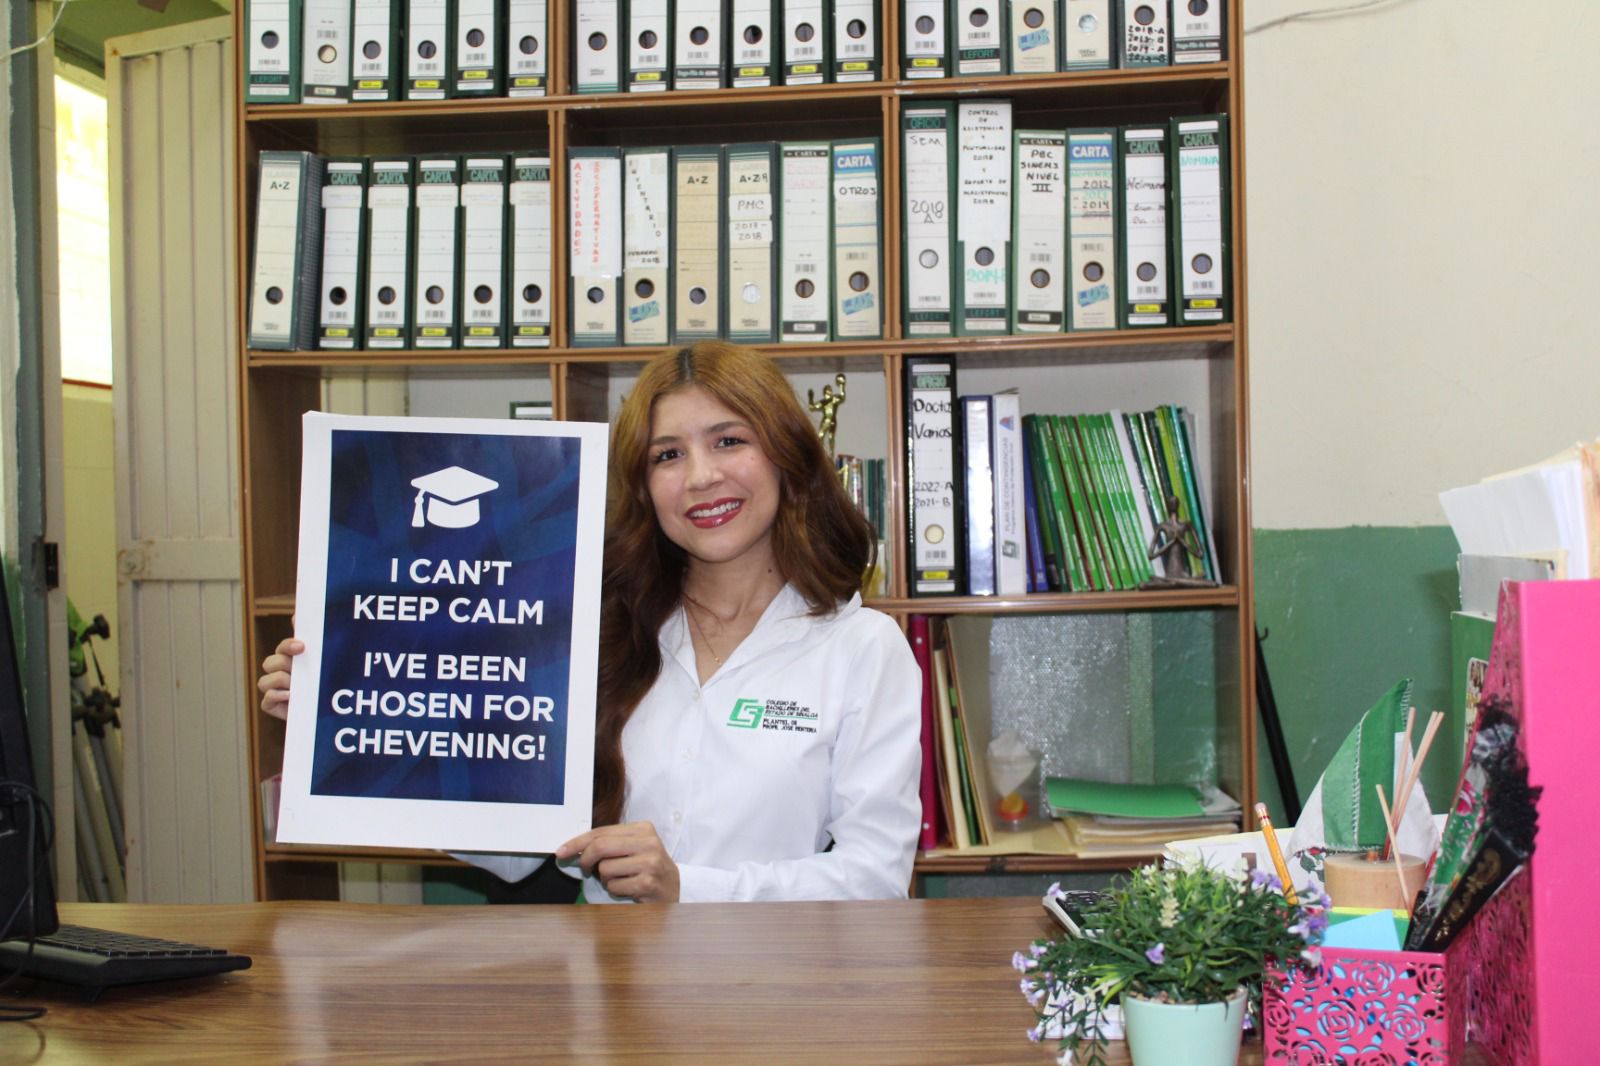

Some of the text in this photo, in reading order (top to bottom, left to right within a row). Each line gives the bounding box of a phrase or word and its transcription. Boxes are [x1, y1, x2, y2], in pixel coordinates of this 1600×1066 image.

[1184, 133, 1215, 146] CARTA
[1072, 146, 1109, 158] CARTA
[1130, 142, 1160, 153] CARTA
[837, 156, 872, 168] CARTA
[331, 173, 358, 185] CARTA
[376, 172, 405, 185] CARTA
[424, 170, 452, 183] CARTA
[470, 169, 499, 182] CARTA
[519, 168, 548, 181] CARTA
[911, 200, 945, 219] 2018
[1082, 201, 1110, 210] 2014
[392, 558, 511, 585] I CAN'T
[354, 595, 543, 624] KEEP CALM
[365, 653, 525, 681] I'VE BEEN
[332, 690, 554, 721] CHOSEN FOR
[335, 728, 545, 760] CHEVENING!
